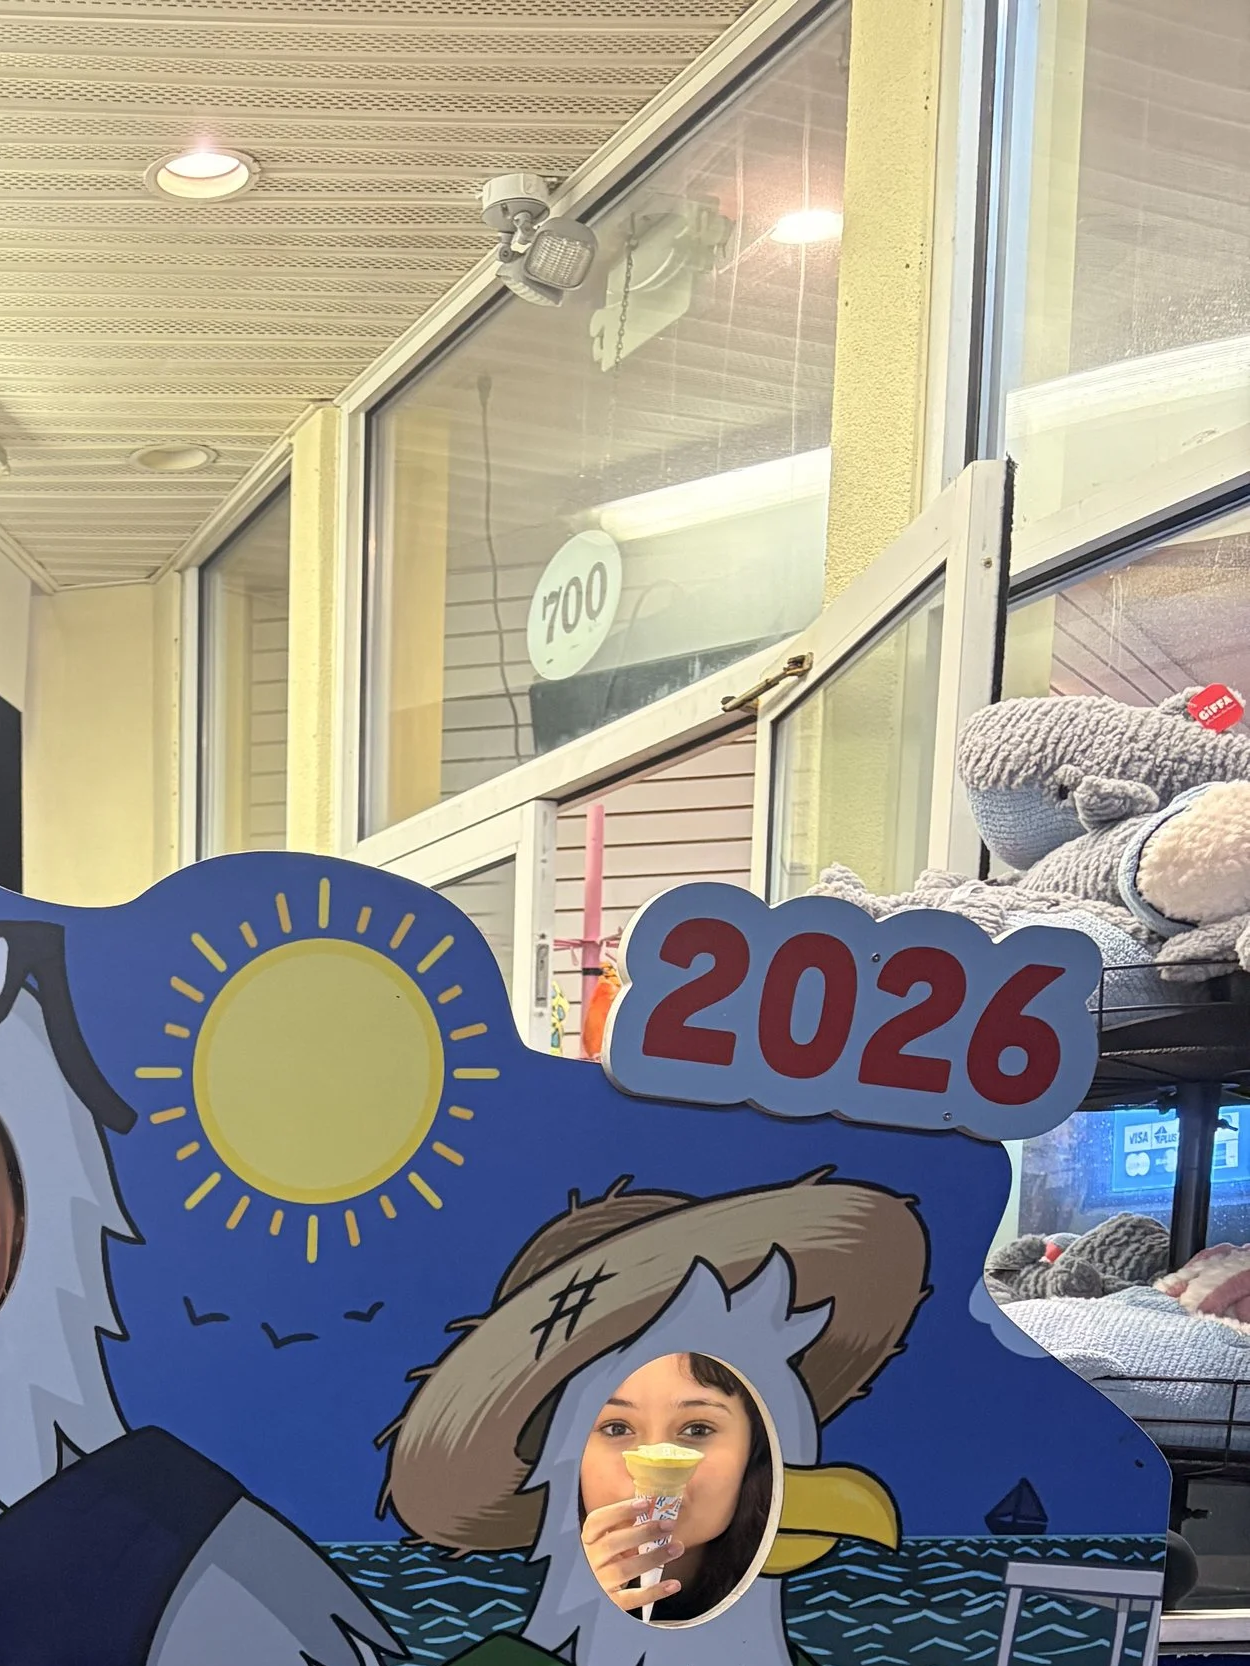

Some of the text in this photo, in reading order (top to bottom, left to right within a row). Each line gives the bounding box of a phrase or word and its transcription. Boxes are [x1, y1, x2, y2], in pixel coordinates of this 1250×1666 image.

[541, 561, 608, 645] 700
[641, 917, 1067, 1106] 2026
[1129, 1131, 1149, 1145] VISA
